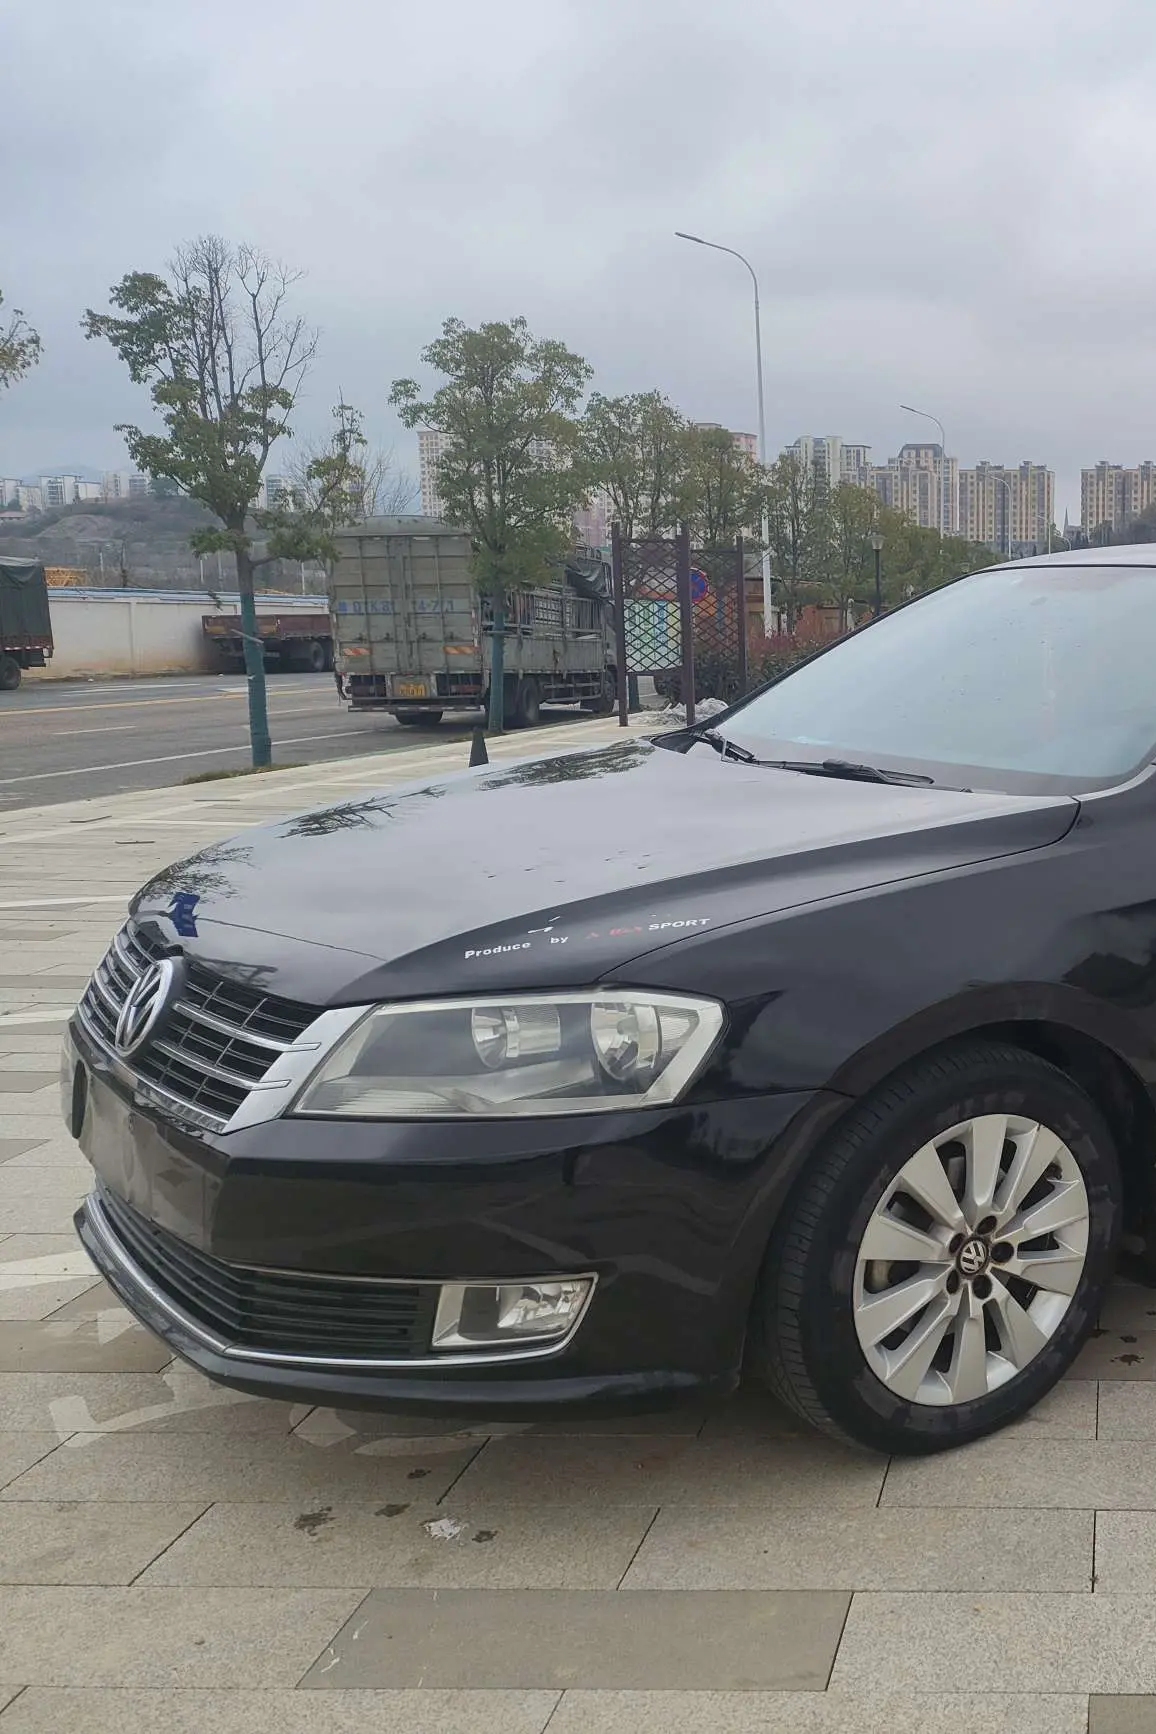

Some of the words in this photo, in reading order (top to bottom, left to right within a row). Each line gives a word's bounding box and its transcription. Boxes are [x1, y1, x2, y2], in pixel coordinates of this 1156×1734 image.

[464, 941, 531, 959] Produce
[550, 935, 569, 945] by
[648, 918, 711, 931] SPORT
